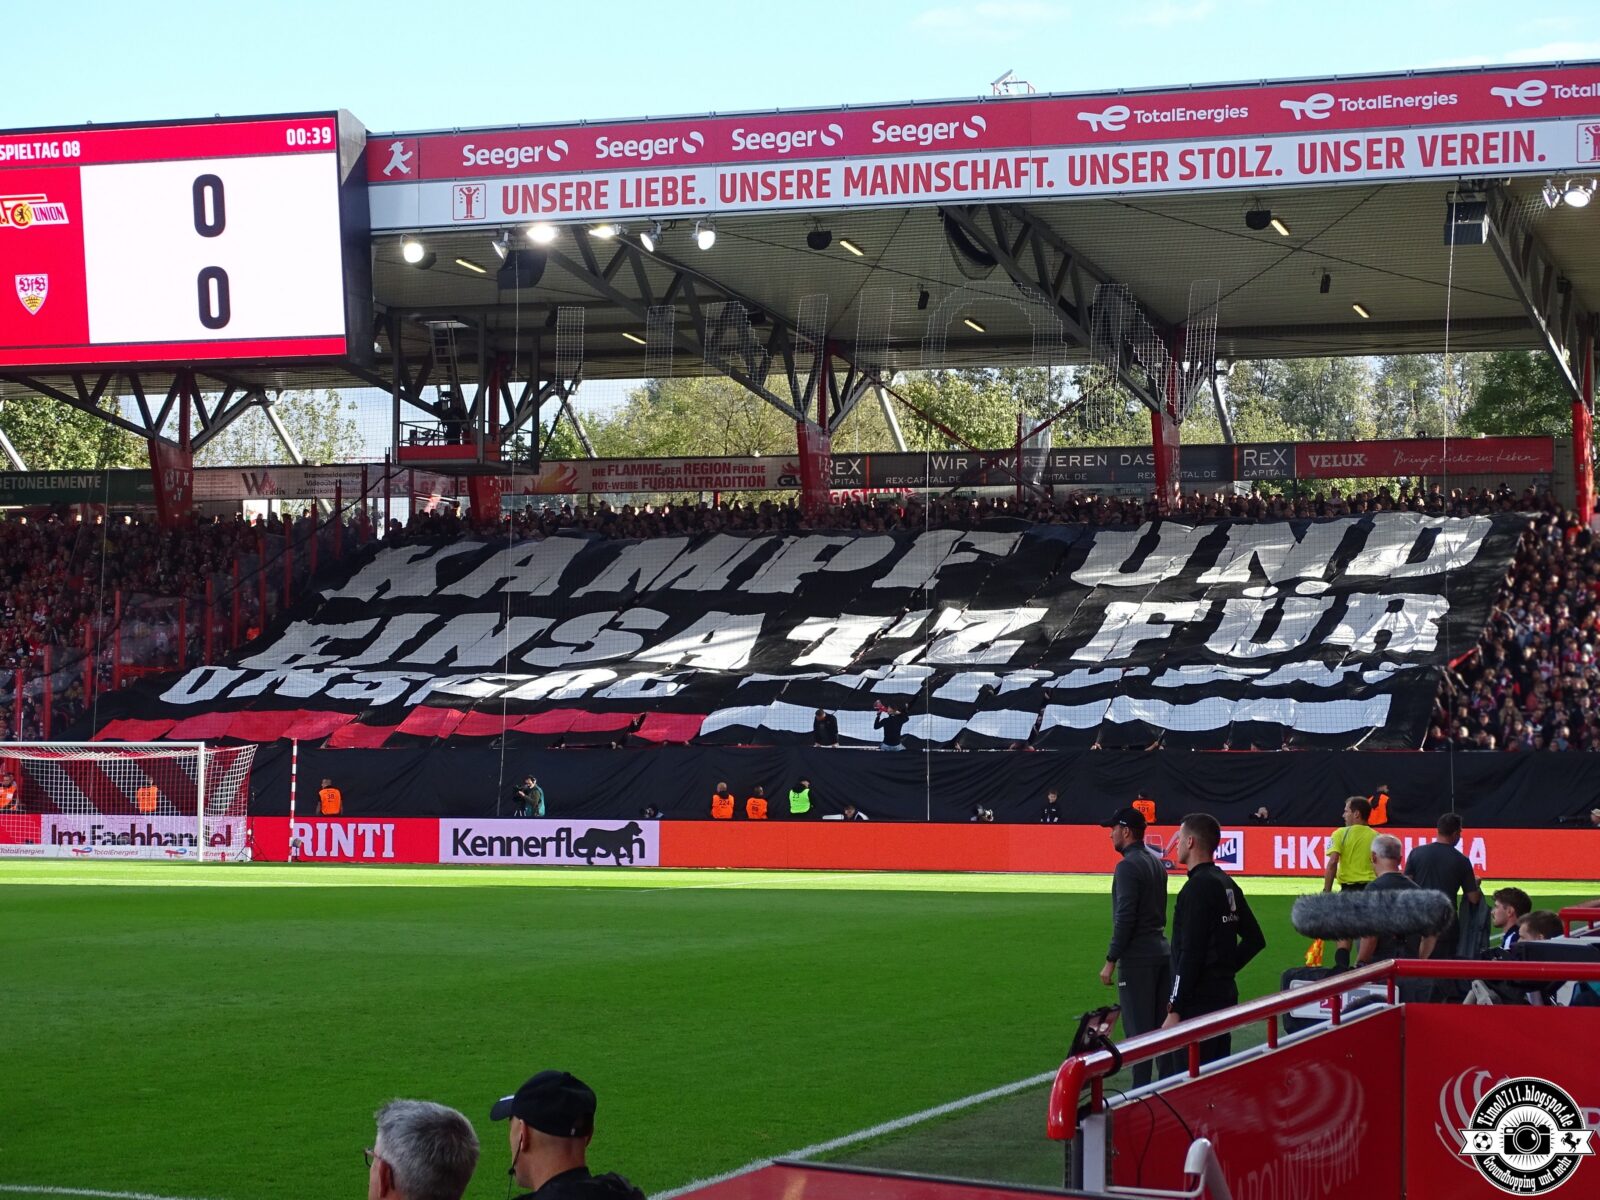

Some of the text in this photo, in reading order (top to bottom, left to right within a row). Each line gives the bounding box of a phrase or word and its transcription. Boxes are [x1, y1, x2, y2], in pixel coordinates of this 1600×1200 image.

[1133, 104, 1249, 124] TotalEnergies
[1338, 91, 1458, 112] TotalEnergies
[286, 126, 332, 146] 00:39
[731, 128, 817, 154] Seeger
[871, 119, 959, 146] Seeger
[62, 140, 81, 158] 08
[462, 144, 543, 169] Seeger
[595, 136, 678, 161] Seeger
[502, 130, 1546, 215] UNSERE LIEBE. UNSERE MANNSCHAFT. UNSER STOLZ. UNSER VEREIN.
[33, 206, 65, 222] UNION
[192, 174, 226, 238] 0
[197, 266, 231, 330] 0
[592, 462, 766, 476] DIE FLAMME DER REGION FÜR DIE
[931, 456, 968, 470] WIR
[1120, 453, 1156, 466] DAS
[1243, 468, 1287, 477] CAPITAL
[1308, 454, 1366, 468] VELUX
[318, 512, 1493, 602] KAMPF UND
[237, 580, 1450, 672] EINSATZ FÜR
[51, 824, 83, 845] Im
[291, 821, 395, 858] RINTI
[452, 827, 646, 860] Kennerflh
